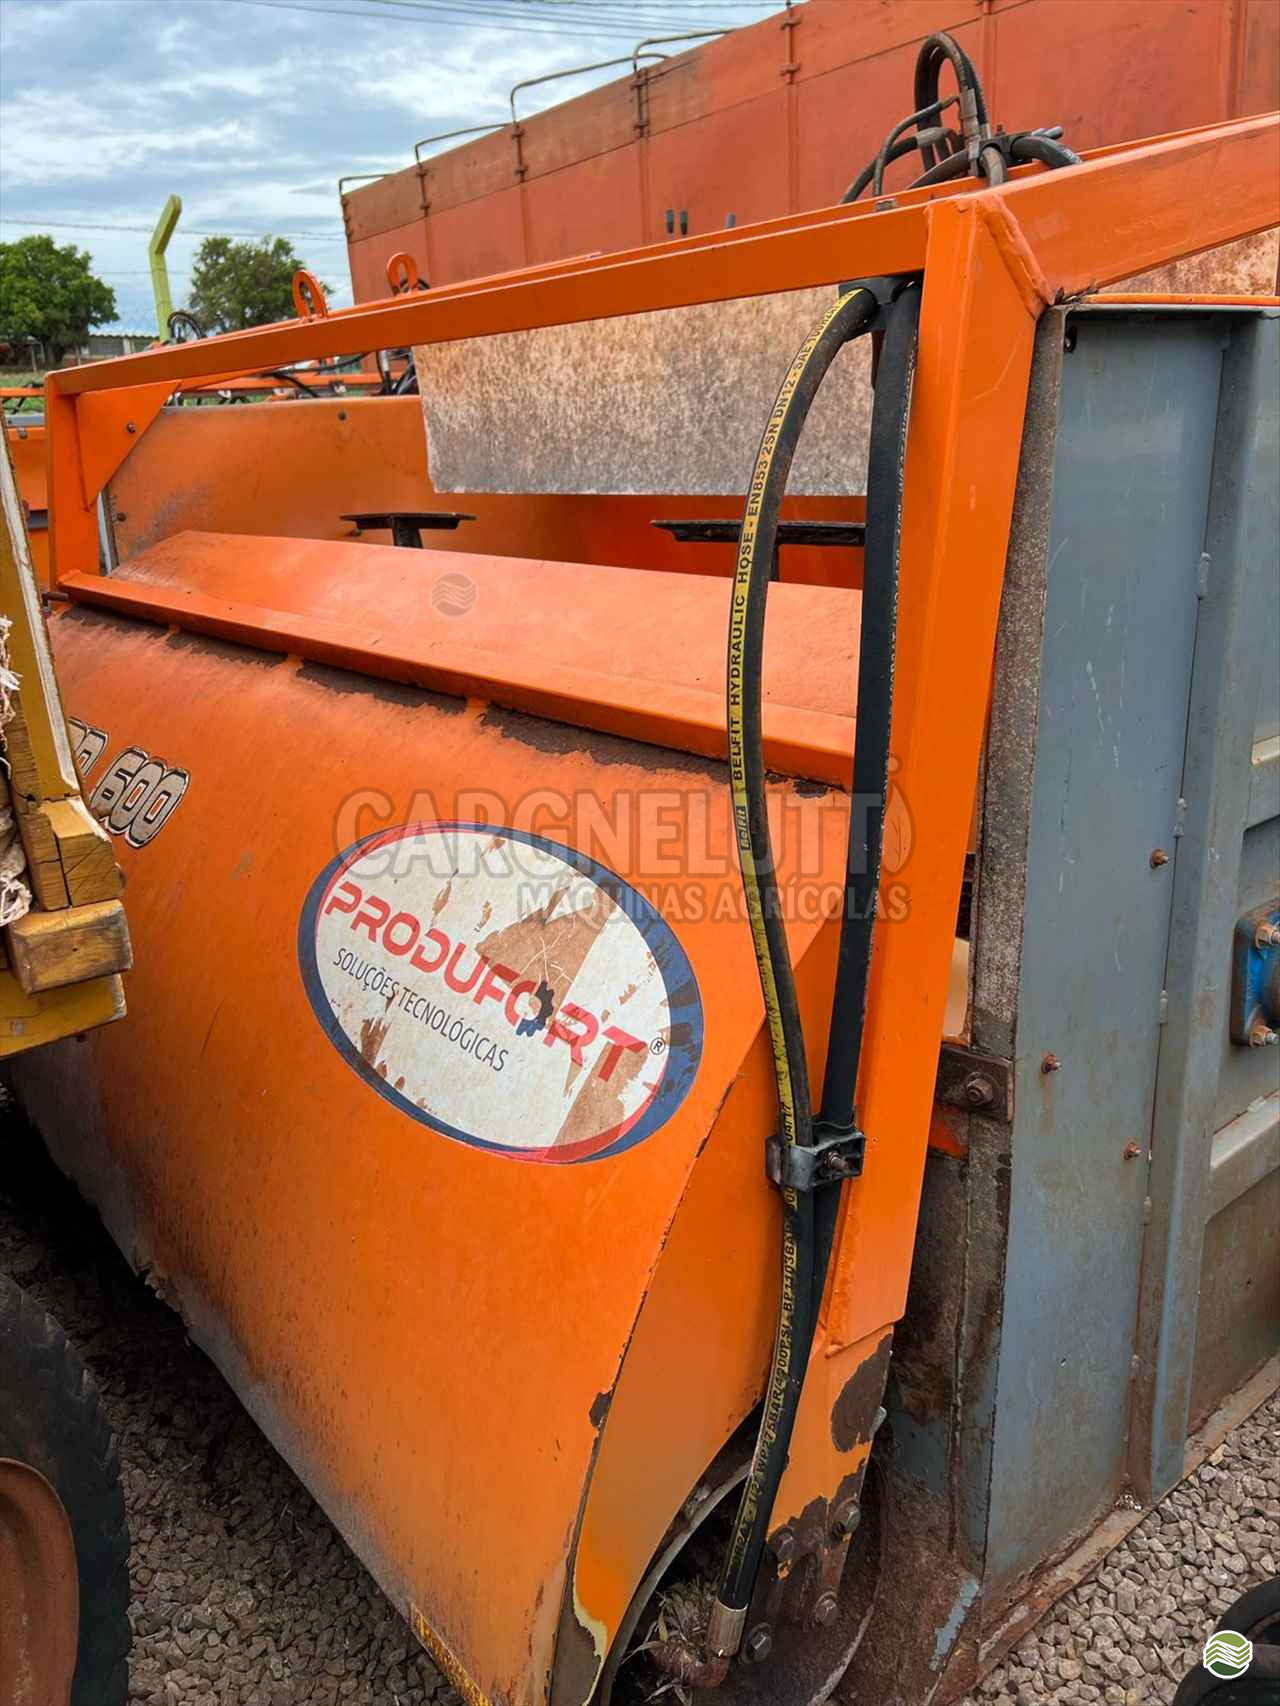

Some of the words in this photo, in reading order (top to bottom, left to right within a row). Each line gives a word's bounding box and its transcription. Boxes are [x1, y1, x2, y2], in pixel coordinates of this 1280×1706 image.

[772, 379, 796, 419] DN12
[760, 422, 779, 455] 2SN
[747, 459, 768, 516] EN853
[737, 532, 754, 584] HOSE
[729, 595, 746, 706] HYDRAULIC
[729, 717, 743, 780] BELFIT
[91, 746, 190, 848] 600
[324, 881, 648, 1082] PRODUFORT
[333, 947, 399, 1002] SOLUÇÕES
[398, 986, 509, 1072] TECNOLÓGICAS
